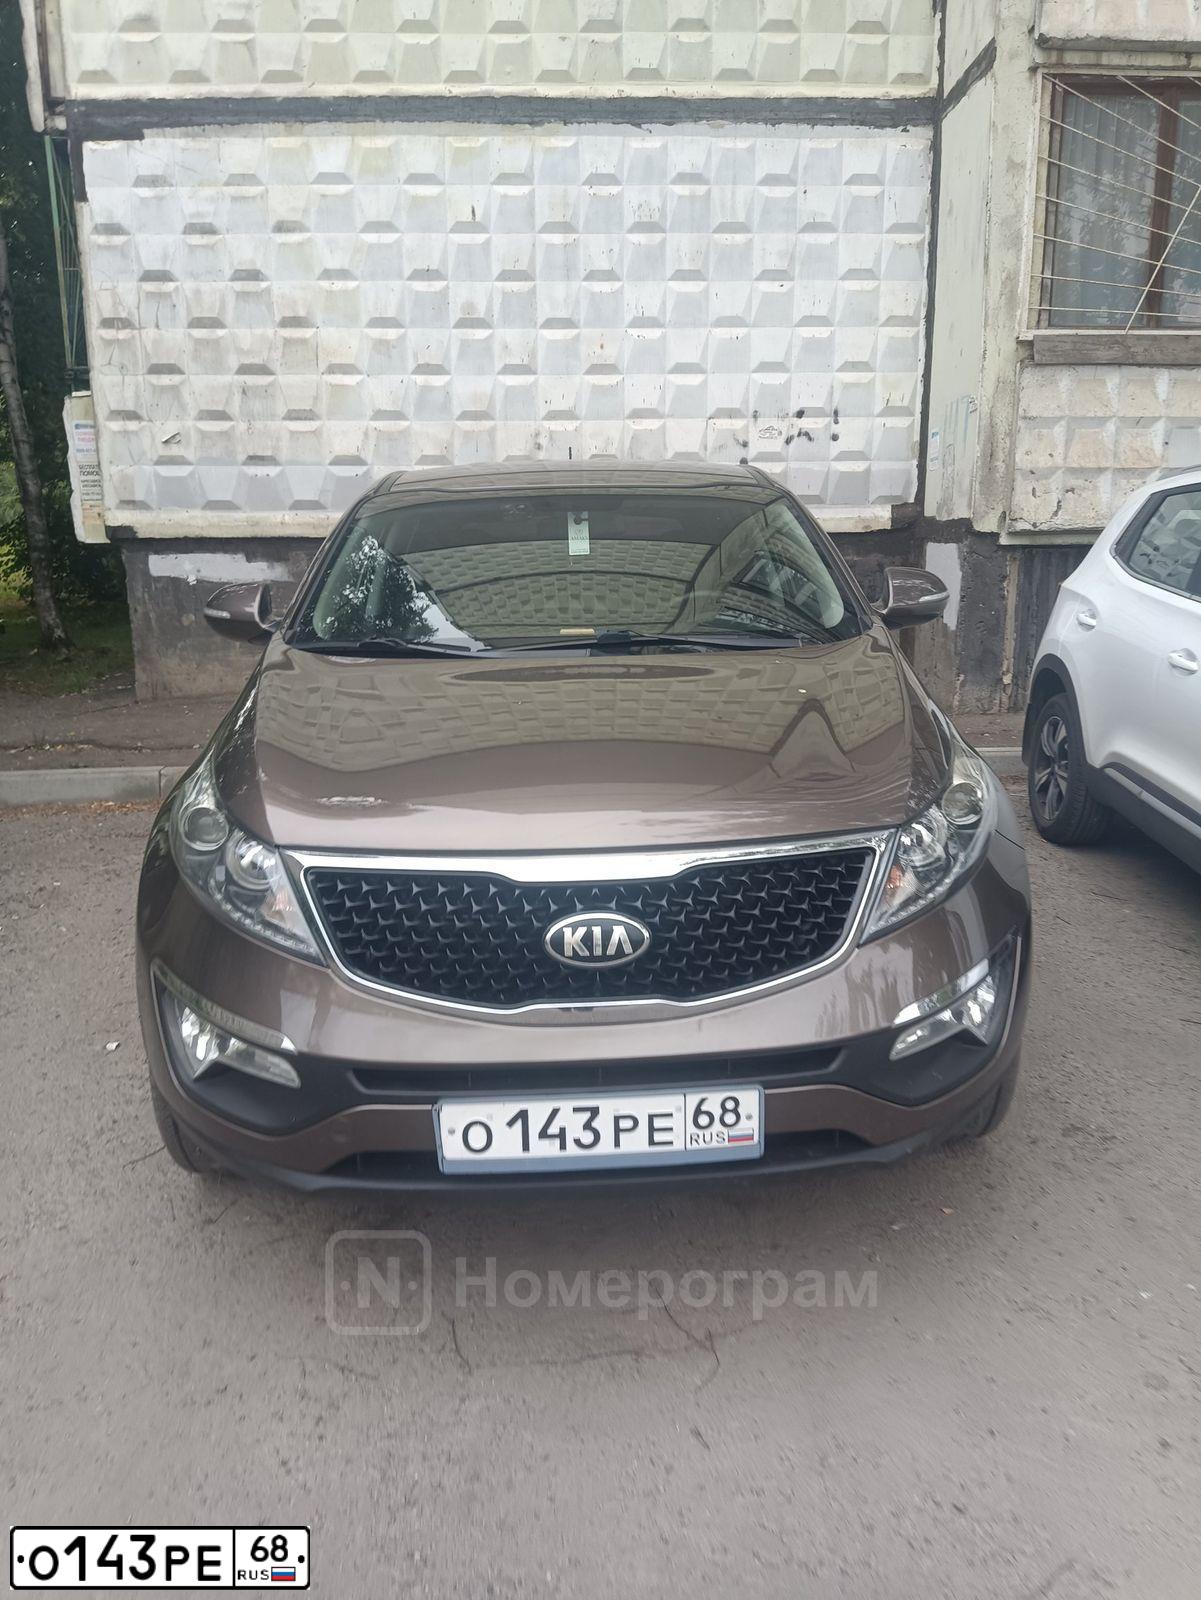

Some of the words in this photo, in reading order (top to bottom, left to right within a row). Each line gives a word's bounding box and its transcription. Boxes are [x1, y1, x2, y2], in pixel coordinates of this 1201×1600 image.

[562, 925, 634, 957] KIA
[692, 1096, 741, 1130] 68
[689, 1131, 726, 1146] RUS
